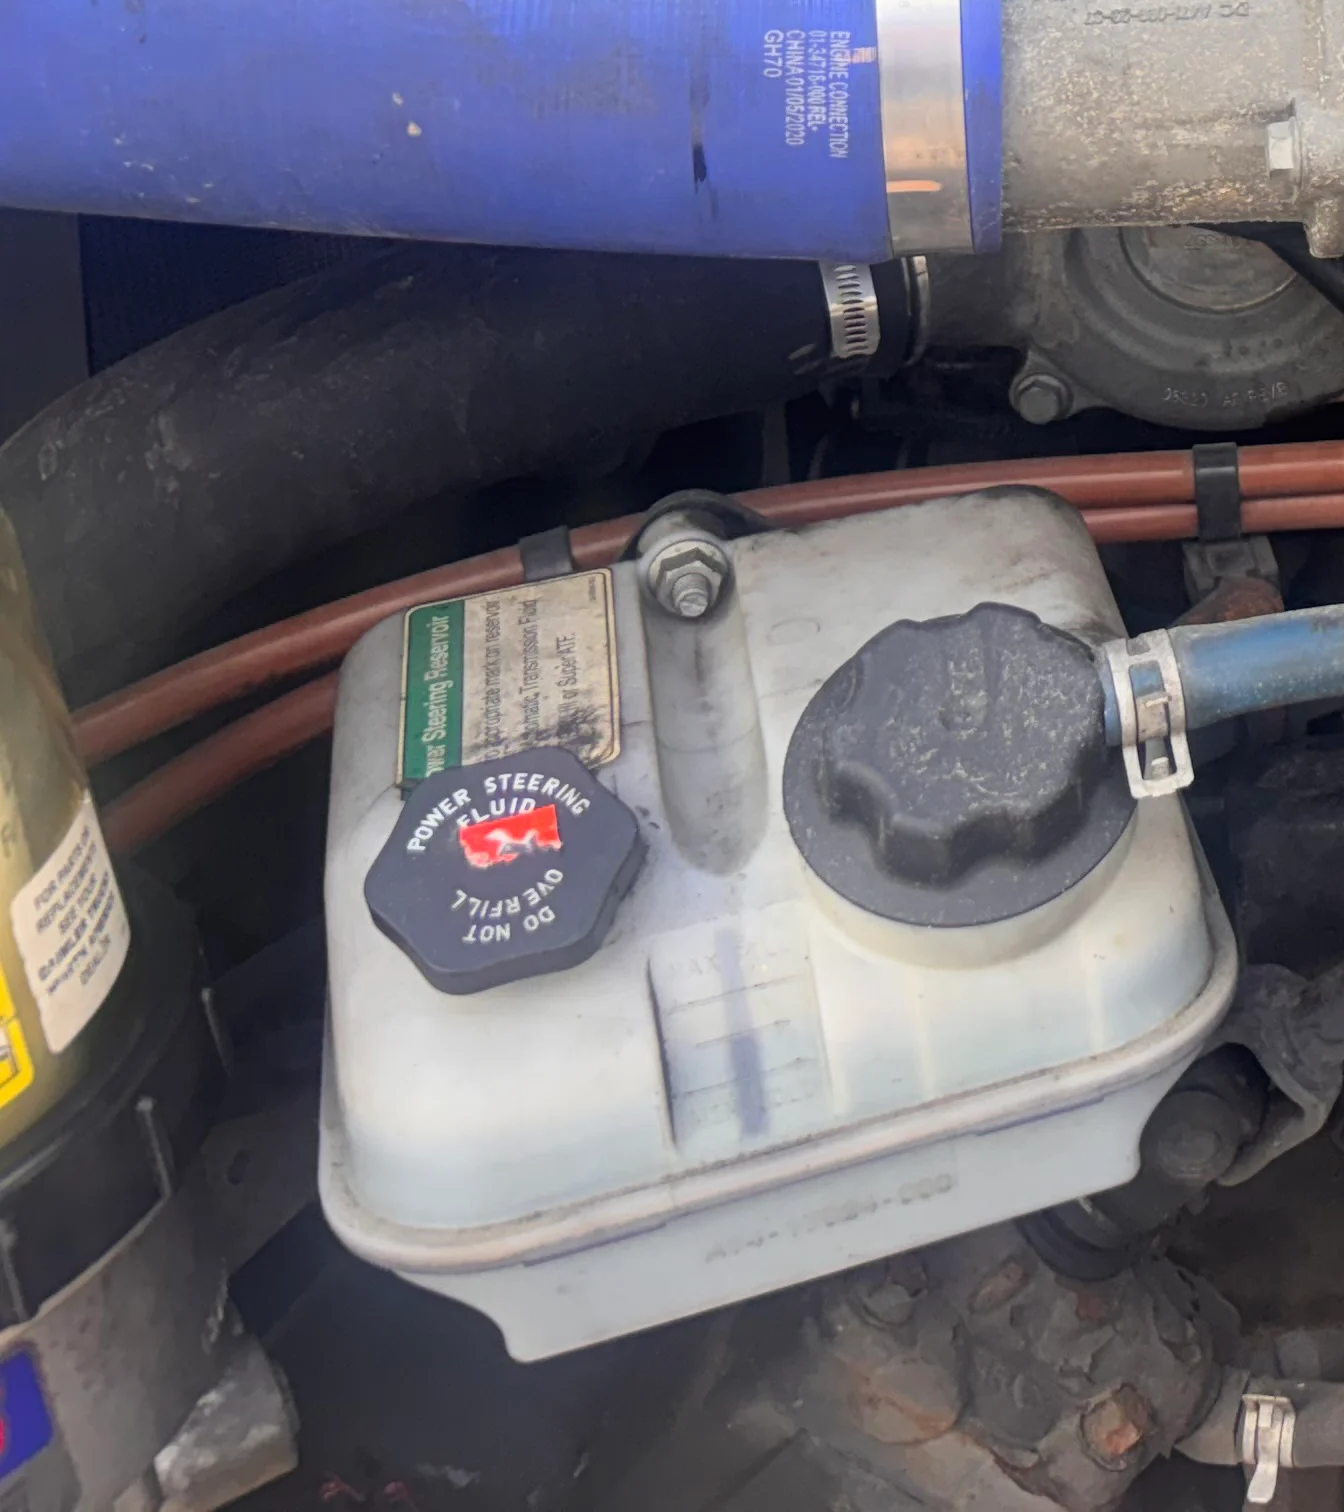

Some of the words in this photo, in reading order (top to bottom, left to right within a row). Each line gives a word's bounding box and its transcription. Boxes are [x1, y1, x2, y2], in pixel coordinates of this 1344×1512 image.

[763, 29, 784, 78] GH70
[785, 30, 806, 76] CHINA
[828, 31, 851, 80] ENGINE
[828, 81, 849, 159] CONNECTION
[424, 615, 449, 680] Reservoir
[518, 625, 541, 694] Transmission
[421, 680, 453, 743] Steering
[407, 788, 472, 853] POWER
[484, 772, 591, 816] STEERING
[455, 797, 537, 828] FLUID
[451, 868, 565, 918] OVERFILL
[462, 922, 511, 944] NOT
[523, 906, 556, 933] DO
